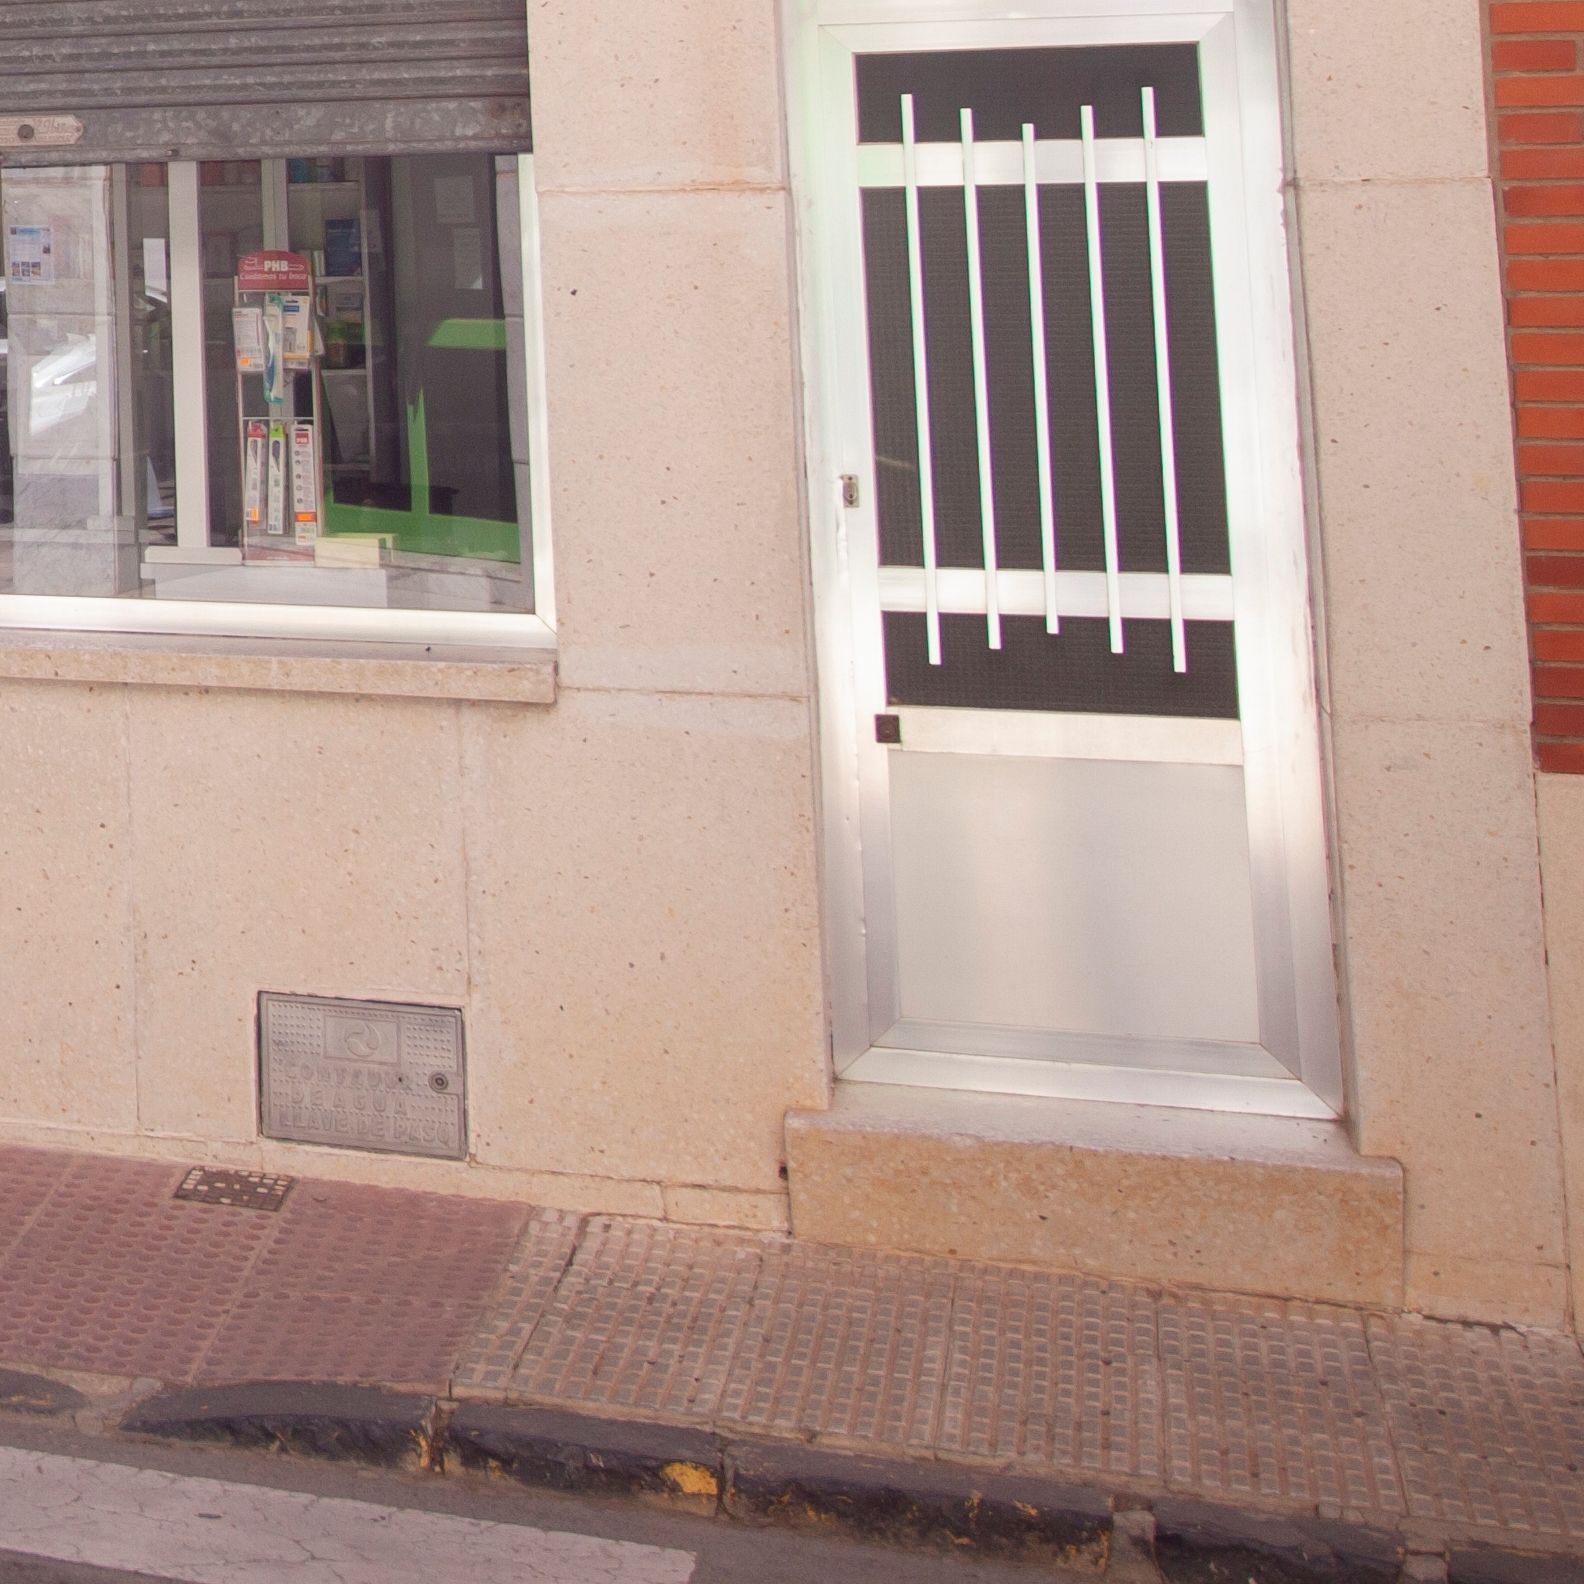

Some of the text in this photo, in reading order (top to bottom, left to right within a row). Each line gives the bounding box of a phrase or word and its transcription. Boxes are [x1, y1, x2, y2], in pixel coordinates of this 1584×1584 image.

[263, 260, 289, 272] PHB
[289, 1084, 409, 1116] DE AGUA
[278, 1109, 452, 1147] LLAVE DE PASO
